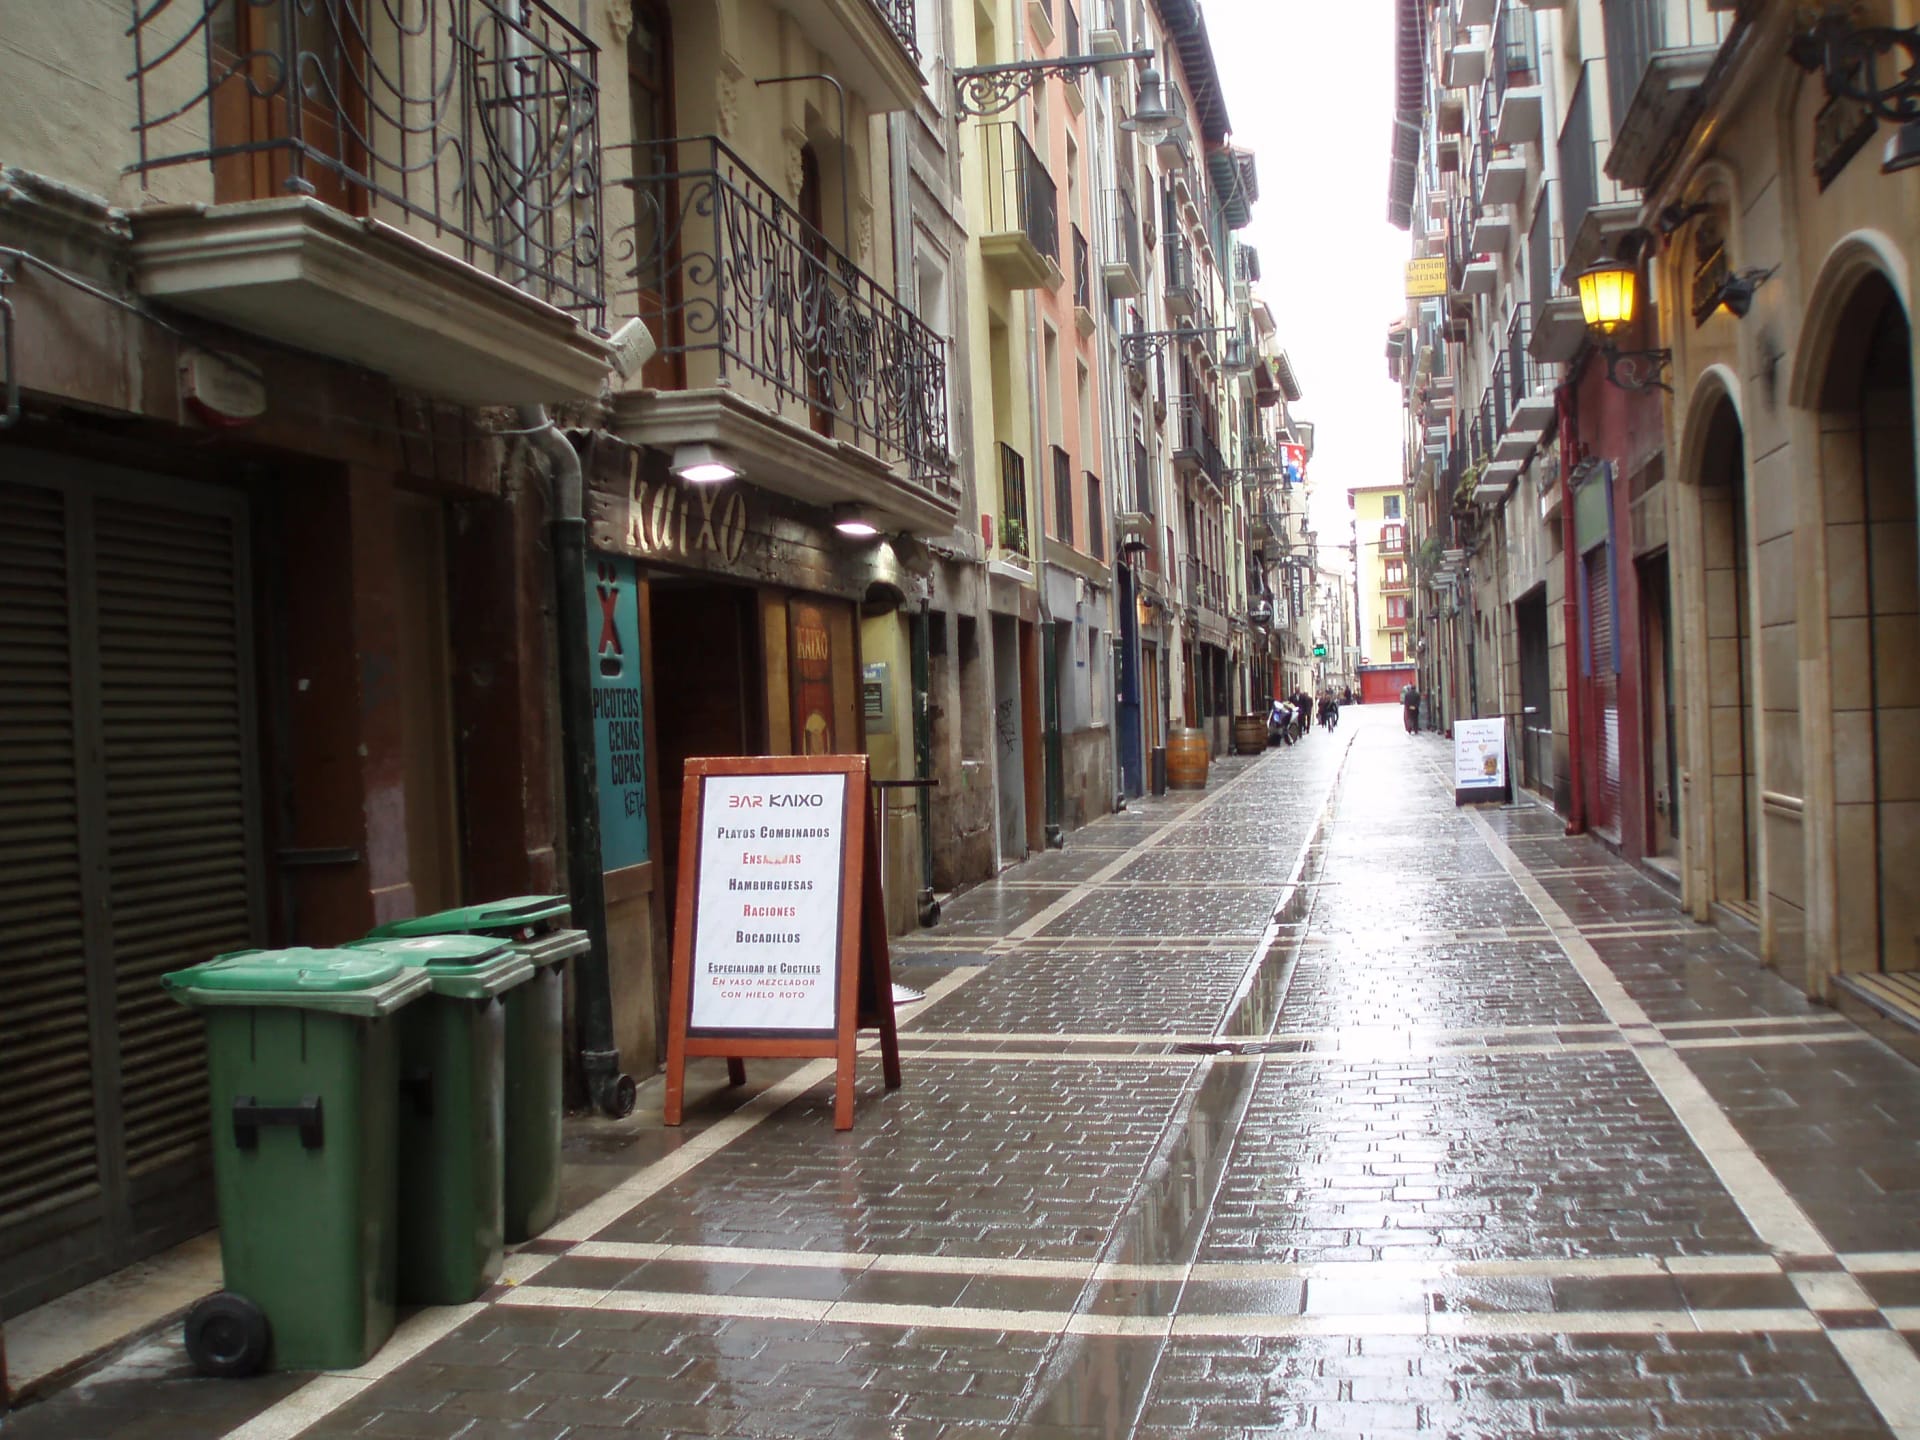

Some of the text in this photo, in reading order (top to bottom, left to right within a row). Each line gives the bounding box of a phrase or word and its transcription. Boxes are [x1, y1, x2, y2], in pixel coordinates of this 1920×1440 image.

[593, 688, 639, 718] PICOTEOS
[608, 721, 640, 752] CENAS
[611, 754, 641, 784] COPAS
[729, 794, 823, 808] BAR KAIXO
[718, 826, 830, 839] PLATOS COMBINADOS
[729, 878, 813, 890] HAMBURGUESAS
[743, 904, 796, 917] RACIONES
[736, 930, 801, 943] BOCADILLOS
[708, 962, 821, 974] ESPECIALIDAD DE COCTELES
[712, 977, 726, 986] EN
[721, 991, 805, 999] CON HIELO ROTO
